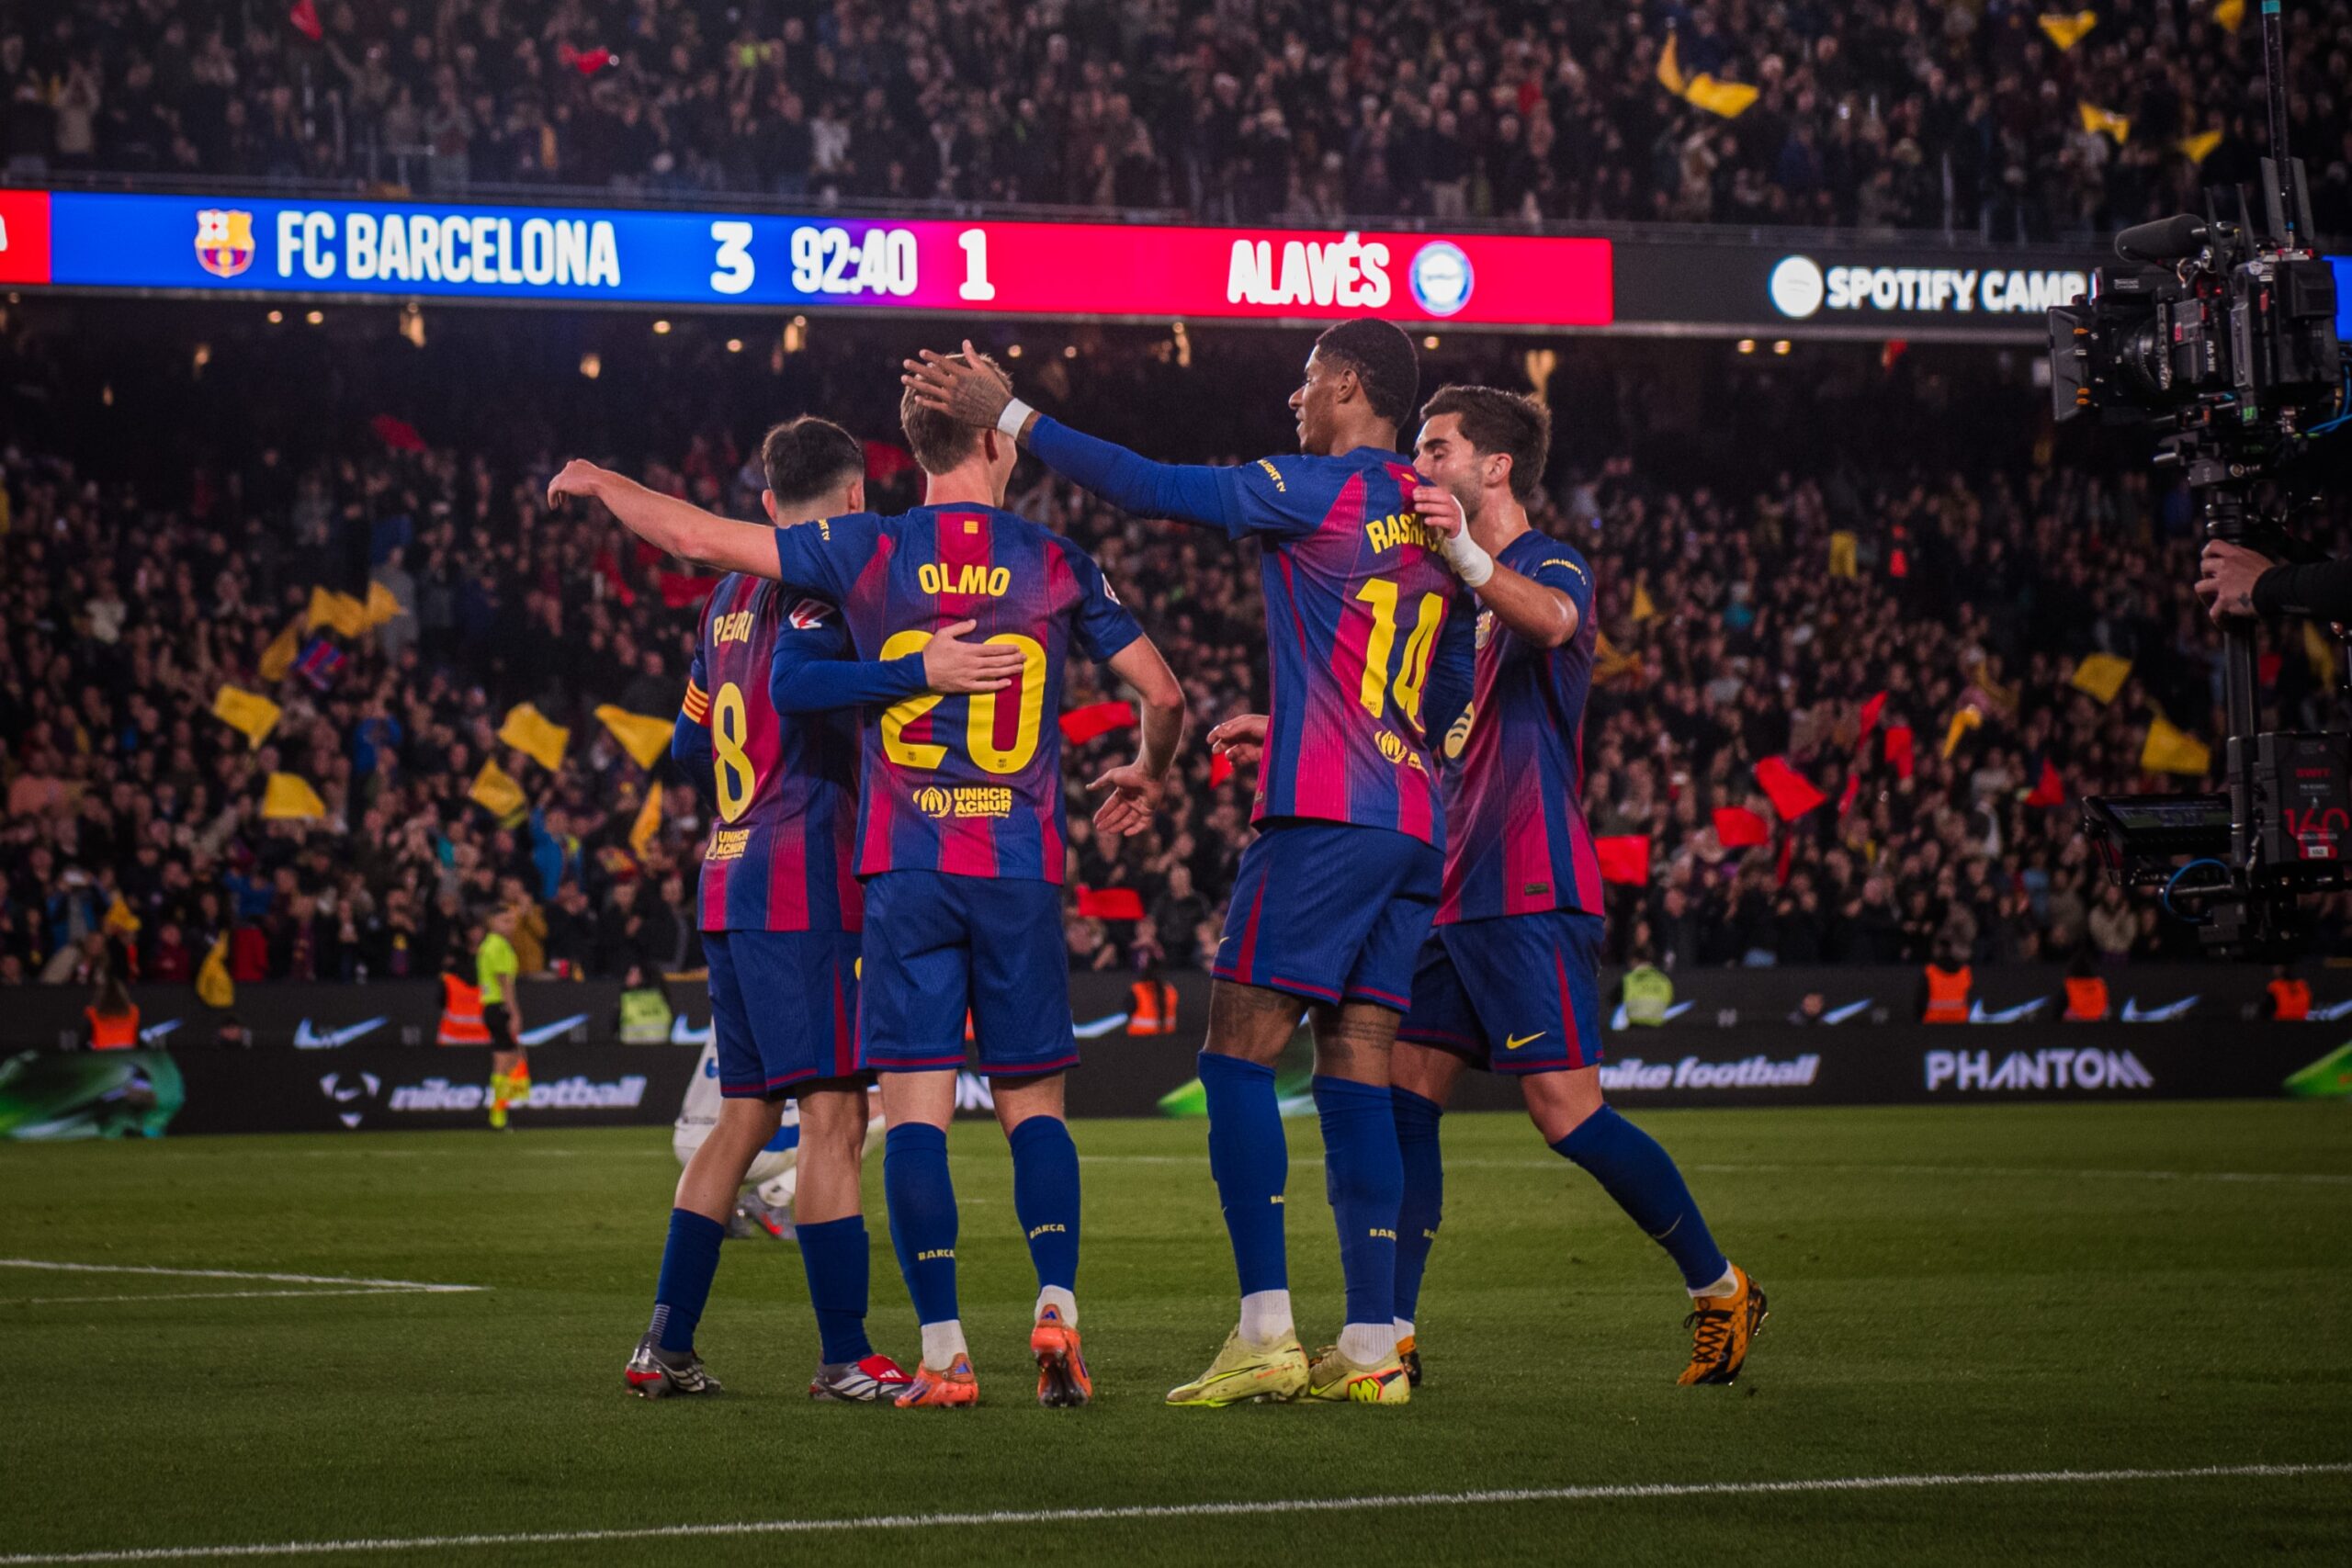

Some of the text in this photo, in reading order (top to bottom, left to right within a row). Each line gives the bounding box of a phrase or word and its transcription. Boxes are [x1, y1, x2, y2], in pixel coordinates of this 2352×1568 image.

[277, 211, 620, 287] FC BARCELONA
[711, 221, 754, 295] 3
[791, 226, 918, 297] 92:40
[958, 229, 995, 301] 1
[1227, 231, 1391, 308] ALAVÉS
[1826, 267, 1974, 310] SPOTIFY
[1980, 270, 2087, 313] CAMP
[919, 563, 1010, 597] OLMO
[1355, 578, 1443, 733] 14
[880, 630, 1046, 774] 20
[713, 682, 755, 824] 8
[954, 787, 1012, 801] UNHCR
[955, 800, 1012, 813] ACNUR
[390, 1079, 482, 1111] nike
[1672, 1054, 1820, 1088] football
[1927, 1048, 2154, 1091] PHANTOM
